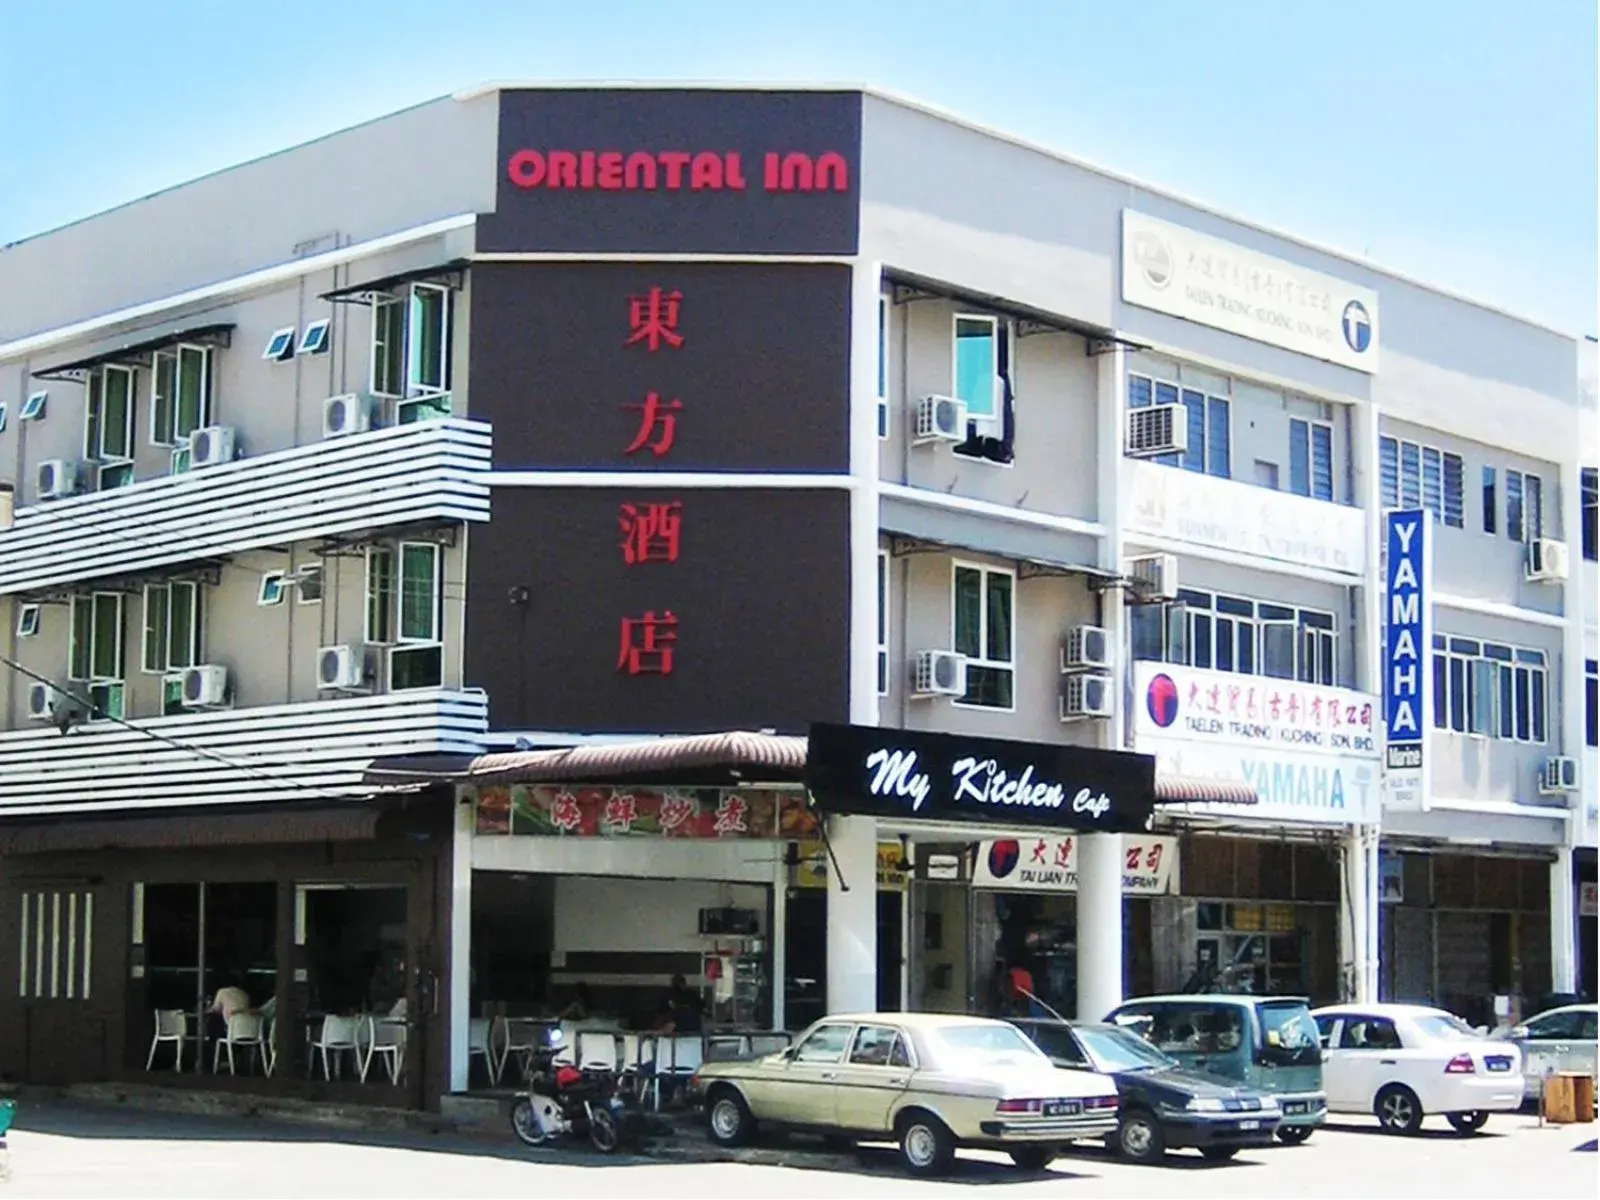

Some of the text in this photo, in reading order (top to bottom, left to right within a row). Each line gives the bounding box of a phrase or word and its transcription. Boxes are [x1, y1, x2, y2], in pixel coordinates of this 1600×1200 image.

[507, 149, 848, 191] ORIENTAL INN
[617, 285, 684, 677] 東方酒店
[1392, 522, 1419, 733] YAMAHA
[866, 749, 931, 811] My
[952, 756, 1065, 810] Kitchen
[1241, 759, 1345, 809] YAMAHA
